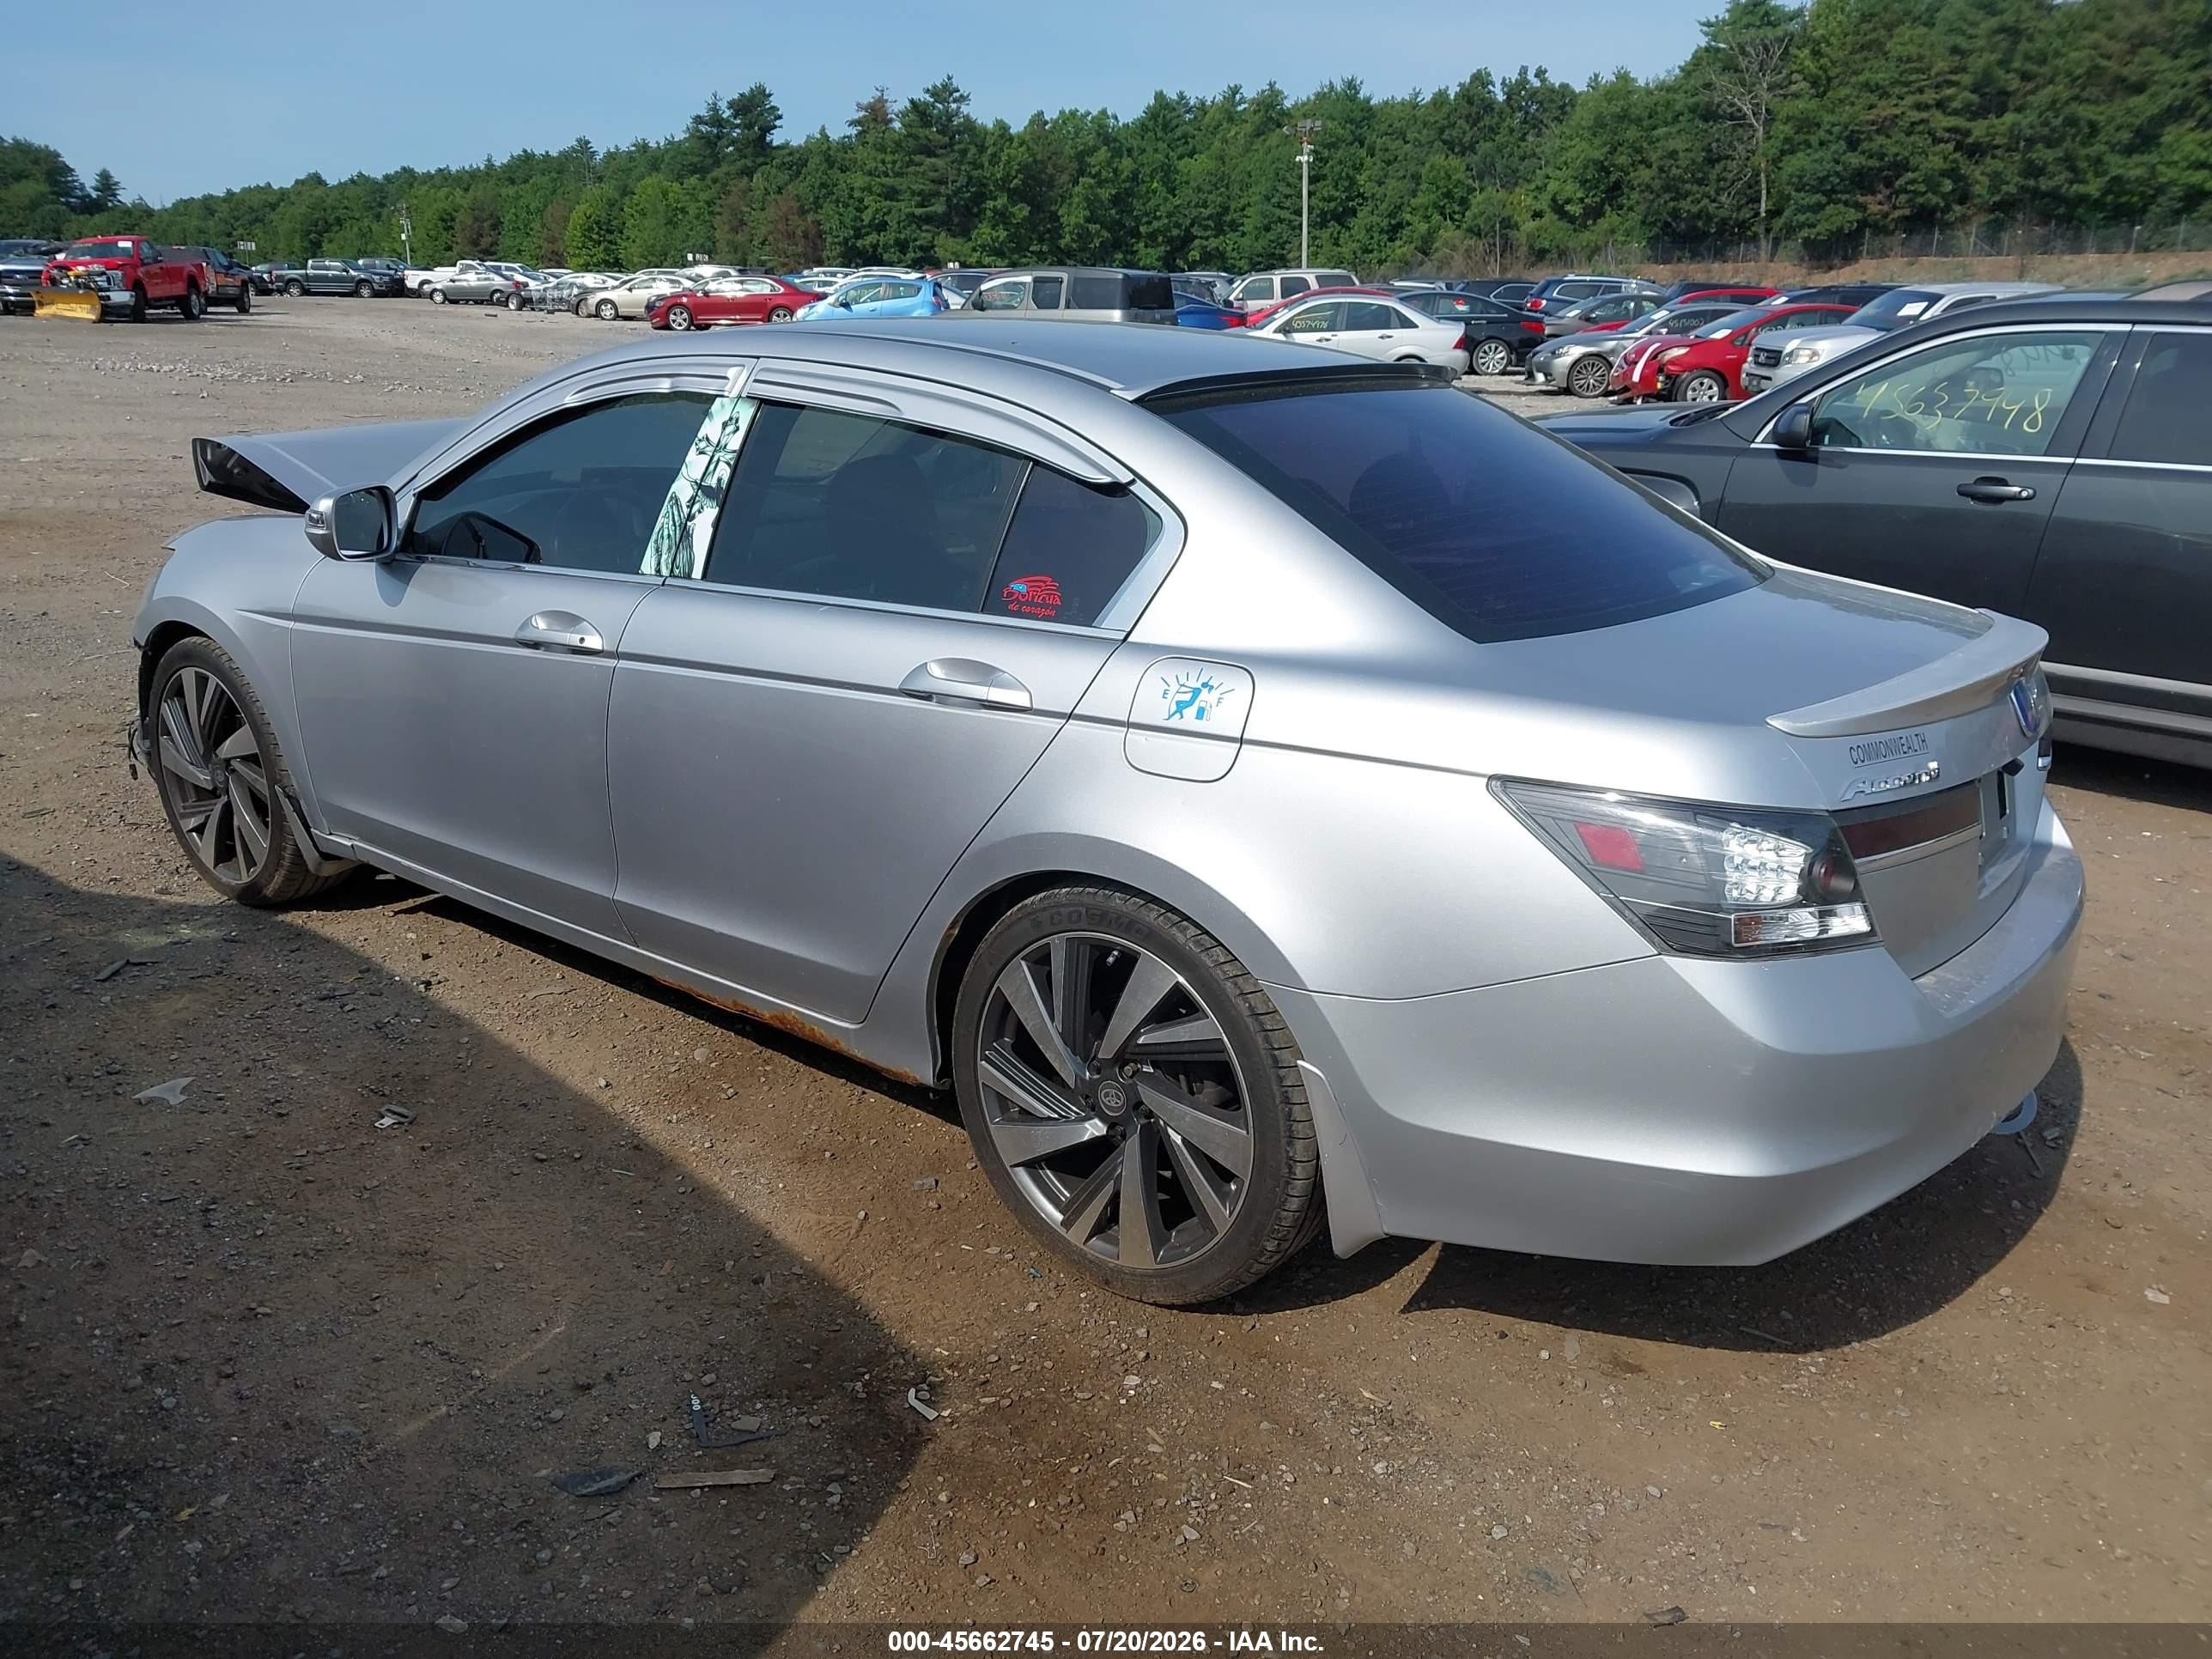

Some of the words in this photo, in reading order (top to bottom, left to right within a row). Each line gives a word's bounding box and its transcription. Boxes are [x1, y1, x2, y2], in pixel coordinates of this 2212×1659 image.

[1855, 381, 2053, 433] 45637948
[1008, 601, 1019, 611] de
[1162, 689, 1170, 699] E
[1216, 696, 1224, 707] F
[1849, 732, 1929, 764] COMMONWEALTH
